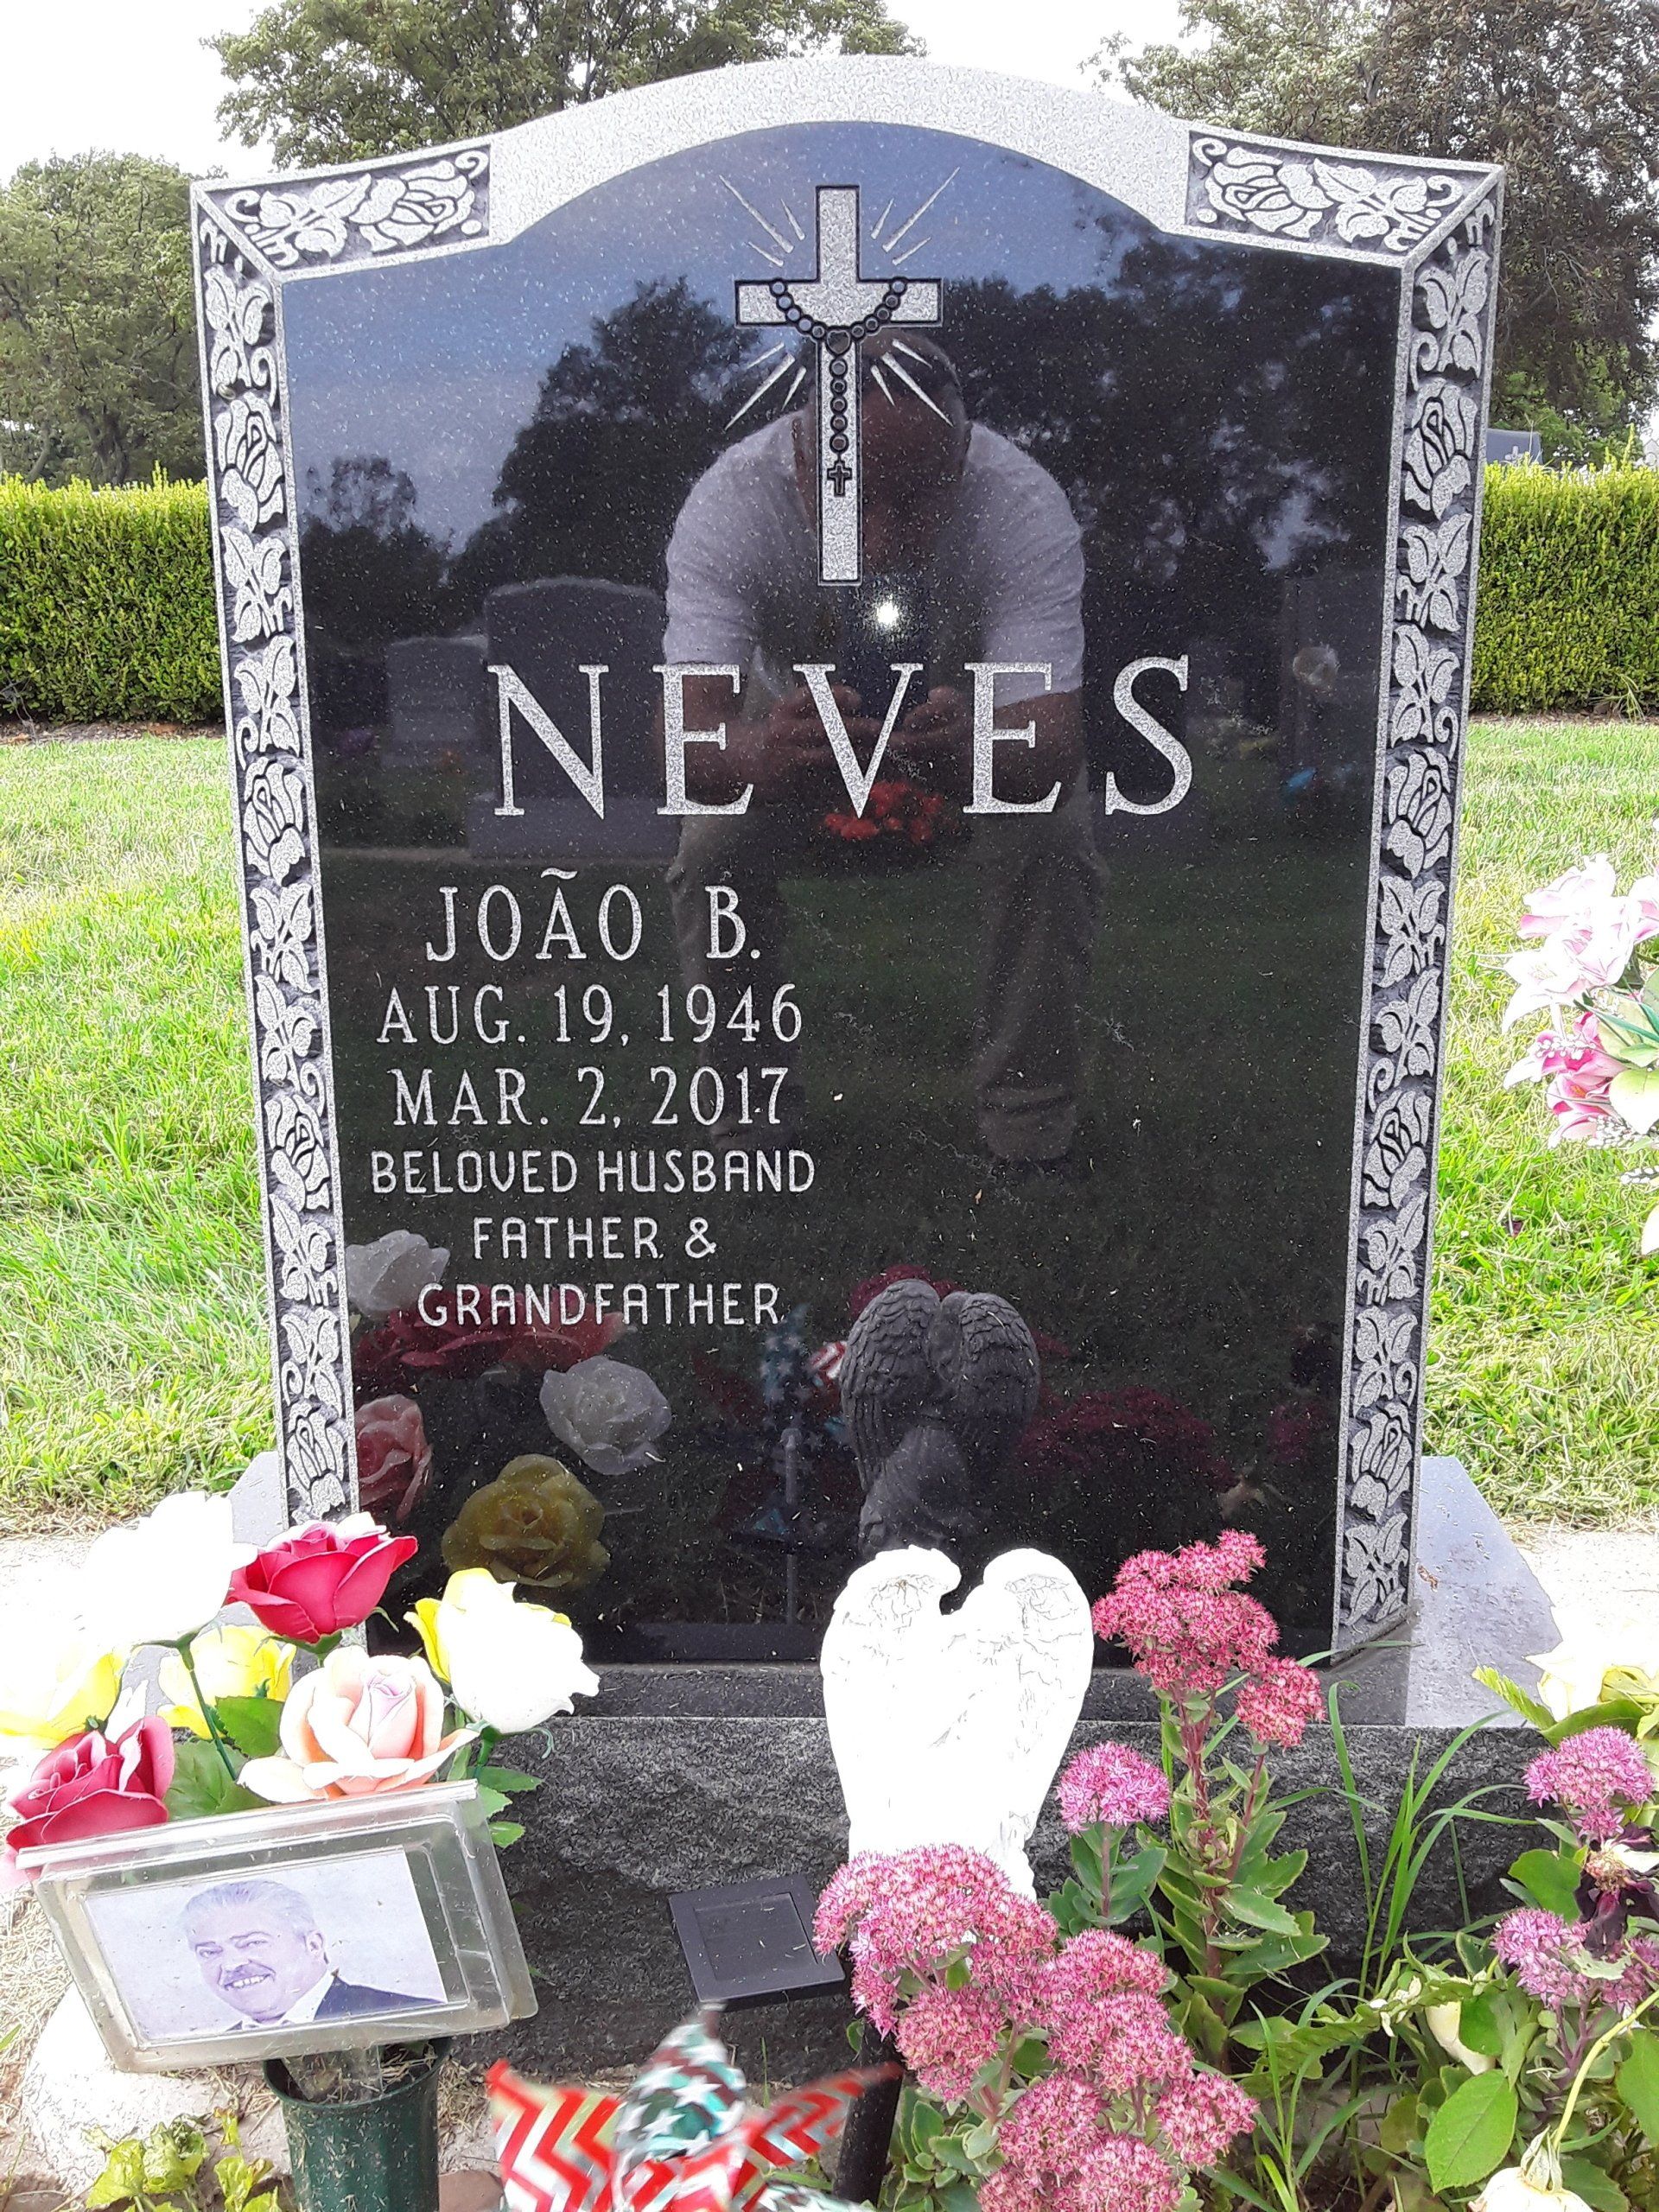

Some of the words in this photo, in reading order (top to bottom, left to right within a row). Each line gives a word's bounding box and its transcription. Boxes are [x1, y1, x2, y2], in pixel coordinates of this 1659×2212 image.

[487, 653, 1194, 819] NEVES
[426, 868, 643, 963] JOÃO
[705, 884, 760, 961] B.
[377, 984, 526, 1045] AUG.
[554, 984, 629, 1046] 19,
[657, 983, 804, 1043] 1946
[387, 1068, 549, 1127] MAR.
[576, 1066, 621, 1128] 2,
[650, 1067, 790, 1127] 2017
[371, 1150, 578, 1194] BELOVED
[598, 1149, 816, 1193] HUSBAND
[474, 1217, 662, 1260] FATHER
[684, 1217, 717, 1259] &
[418, 1282, 782, 1327] GRANDFATHER
